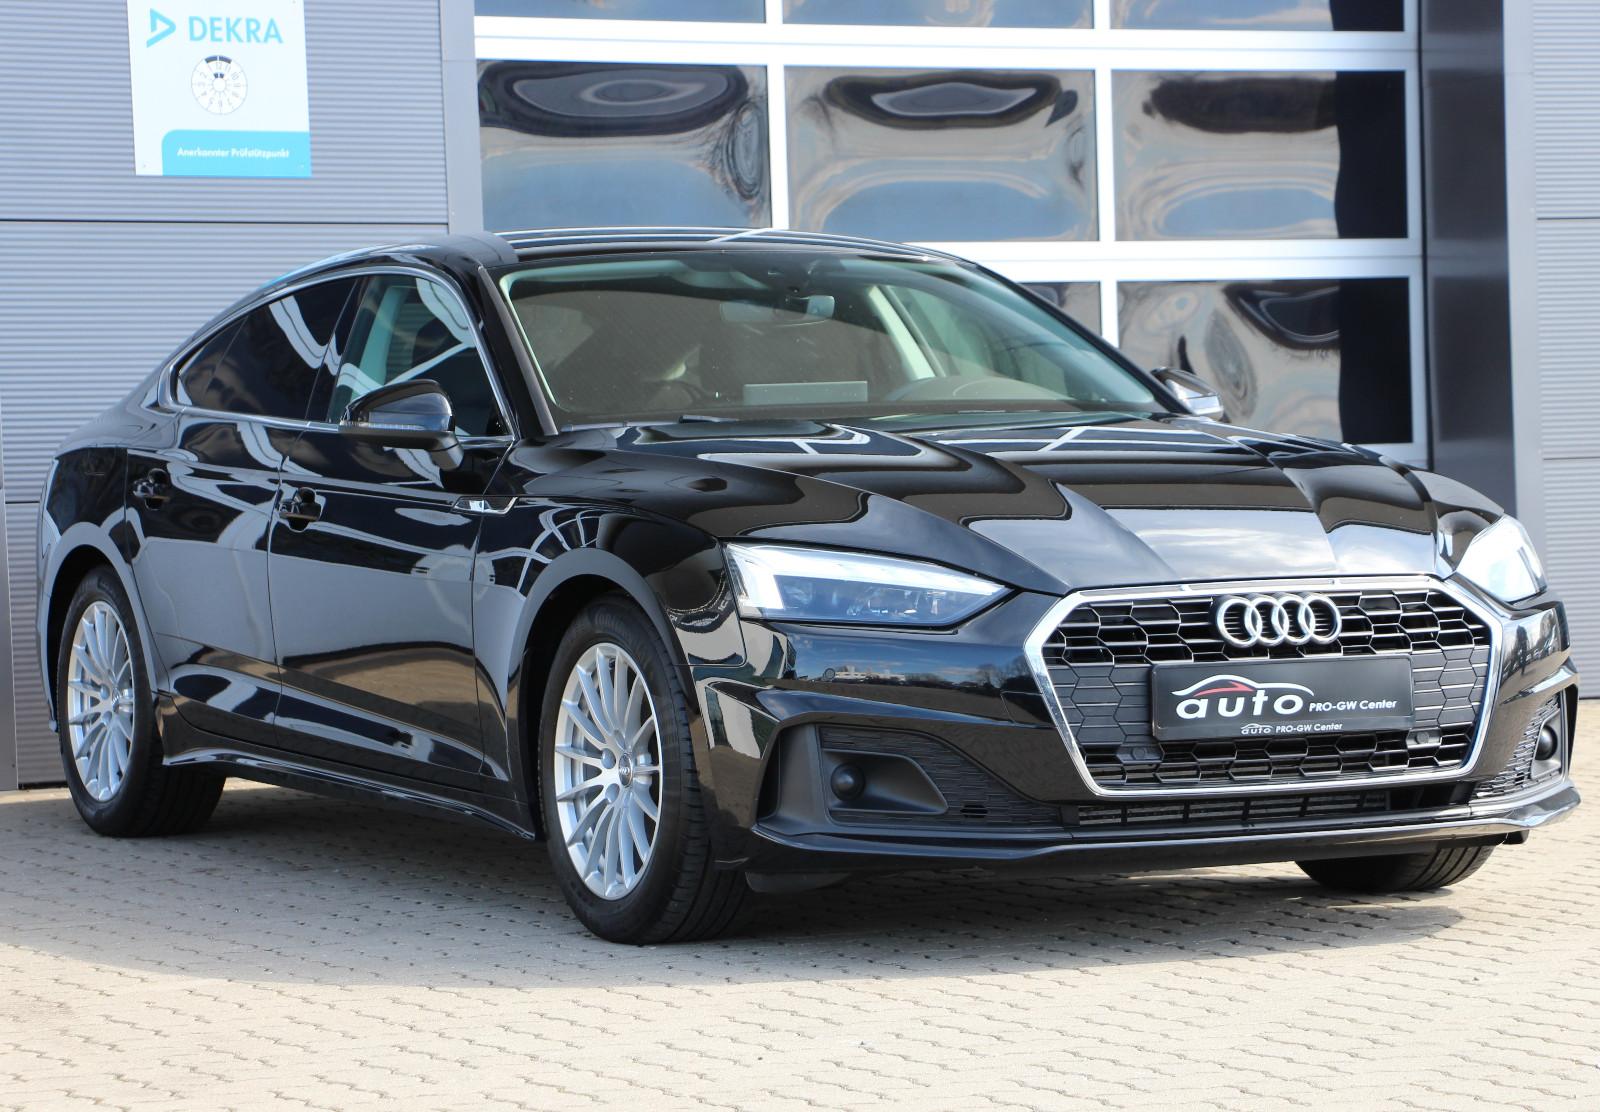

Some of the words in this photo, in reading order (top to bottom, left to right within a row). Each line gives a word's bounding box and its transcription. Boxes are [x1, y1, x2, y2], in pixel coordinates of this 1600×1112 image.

[188, 16, 283, 44] DEKRA
[177, 146, 229, 157] Anerkannter
[231, 146, 289, 160] Prüfstützpunkt
[1175, 689, 1304, 720] auto
[1309, 701, 1358, 712] PRO-GW
[1359, 699, 1398, 710] Center
[1241, 726, 1272, 735] auto
[1275, 724, 1312, 734] PRO-GW
[1313, 723, 1343, 732] Center
